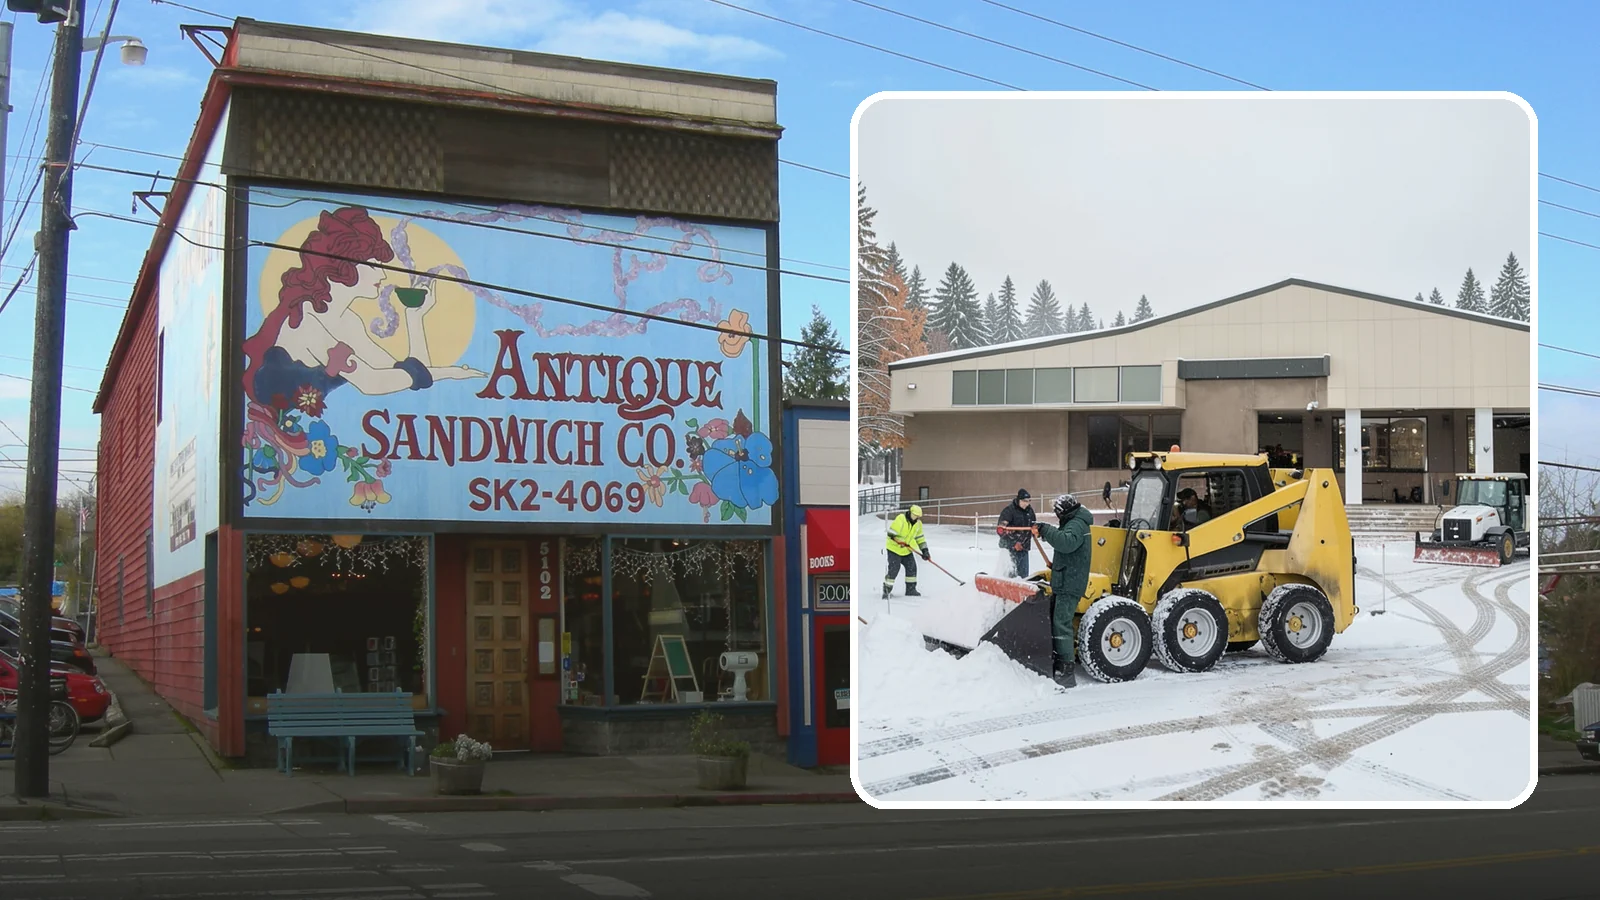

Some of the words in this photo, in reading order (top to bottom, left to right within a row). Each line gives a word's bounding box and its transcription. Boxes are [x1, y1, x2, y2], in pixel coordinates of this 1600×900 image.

[476, 329, 723, 421] ANTIQUE
[361, 408, 605, 467] SANDWICH
[617, 422, 684, 468] CO.
[468, 477, 646, 513] SK2-4069
[540, 541, 551, 600] 5102
[809, 555, 835, 569] BOOKS
